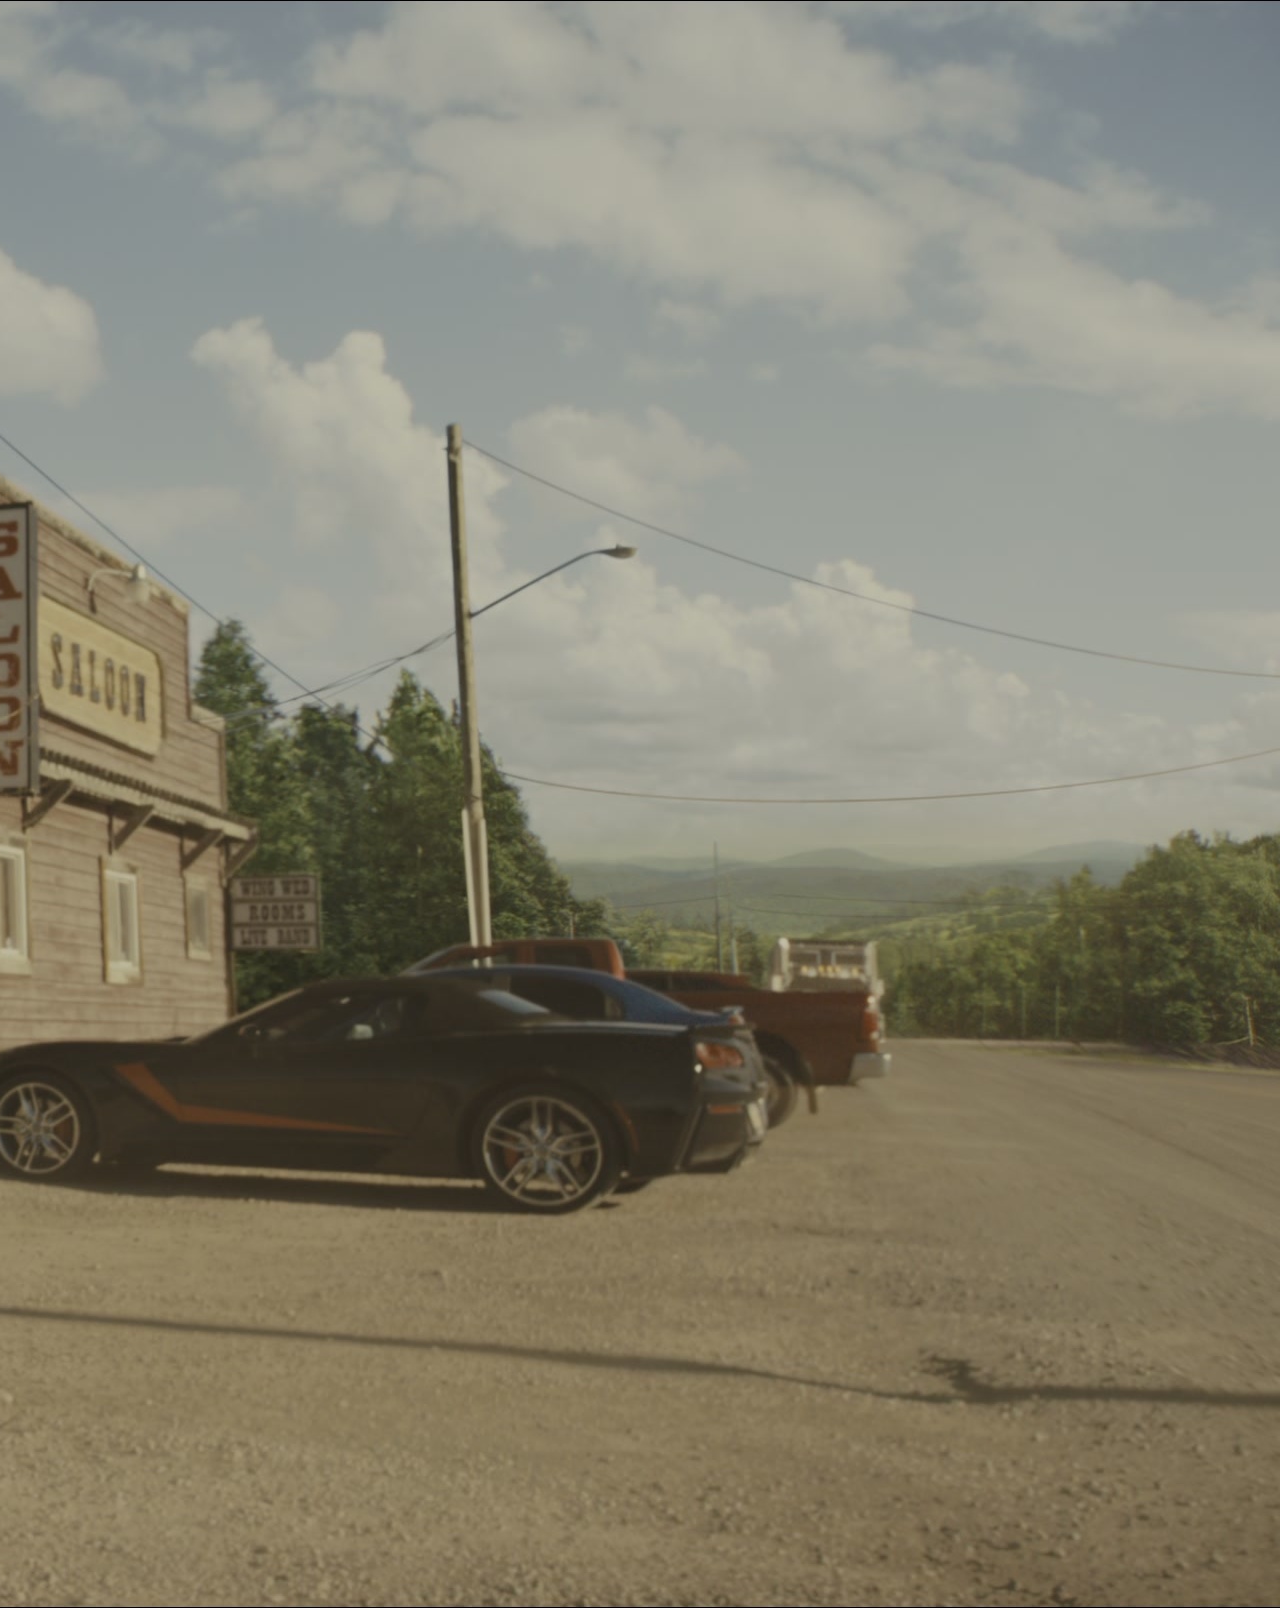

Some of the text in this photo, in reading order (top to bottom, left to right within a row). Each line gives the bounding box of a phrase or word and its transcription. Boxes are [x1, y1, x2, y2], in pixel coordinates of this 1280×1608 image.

[50, 632, 146, 723] SALOON
[249, 905, 305, 920] ROOMS
[240, 929, 310, 946] LIVE BAND
